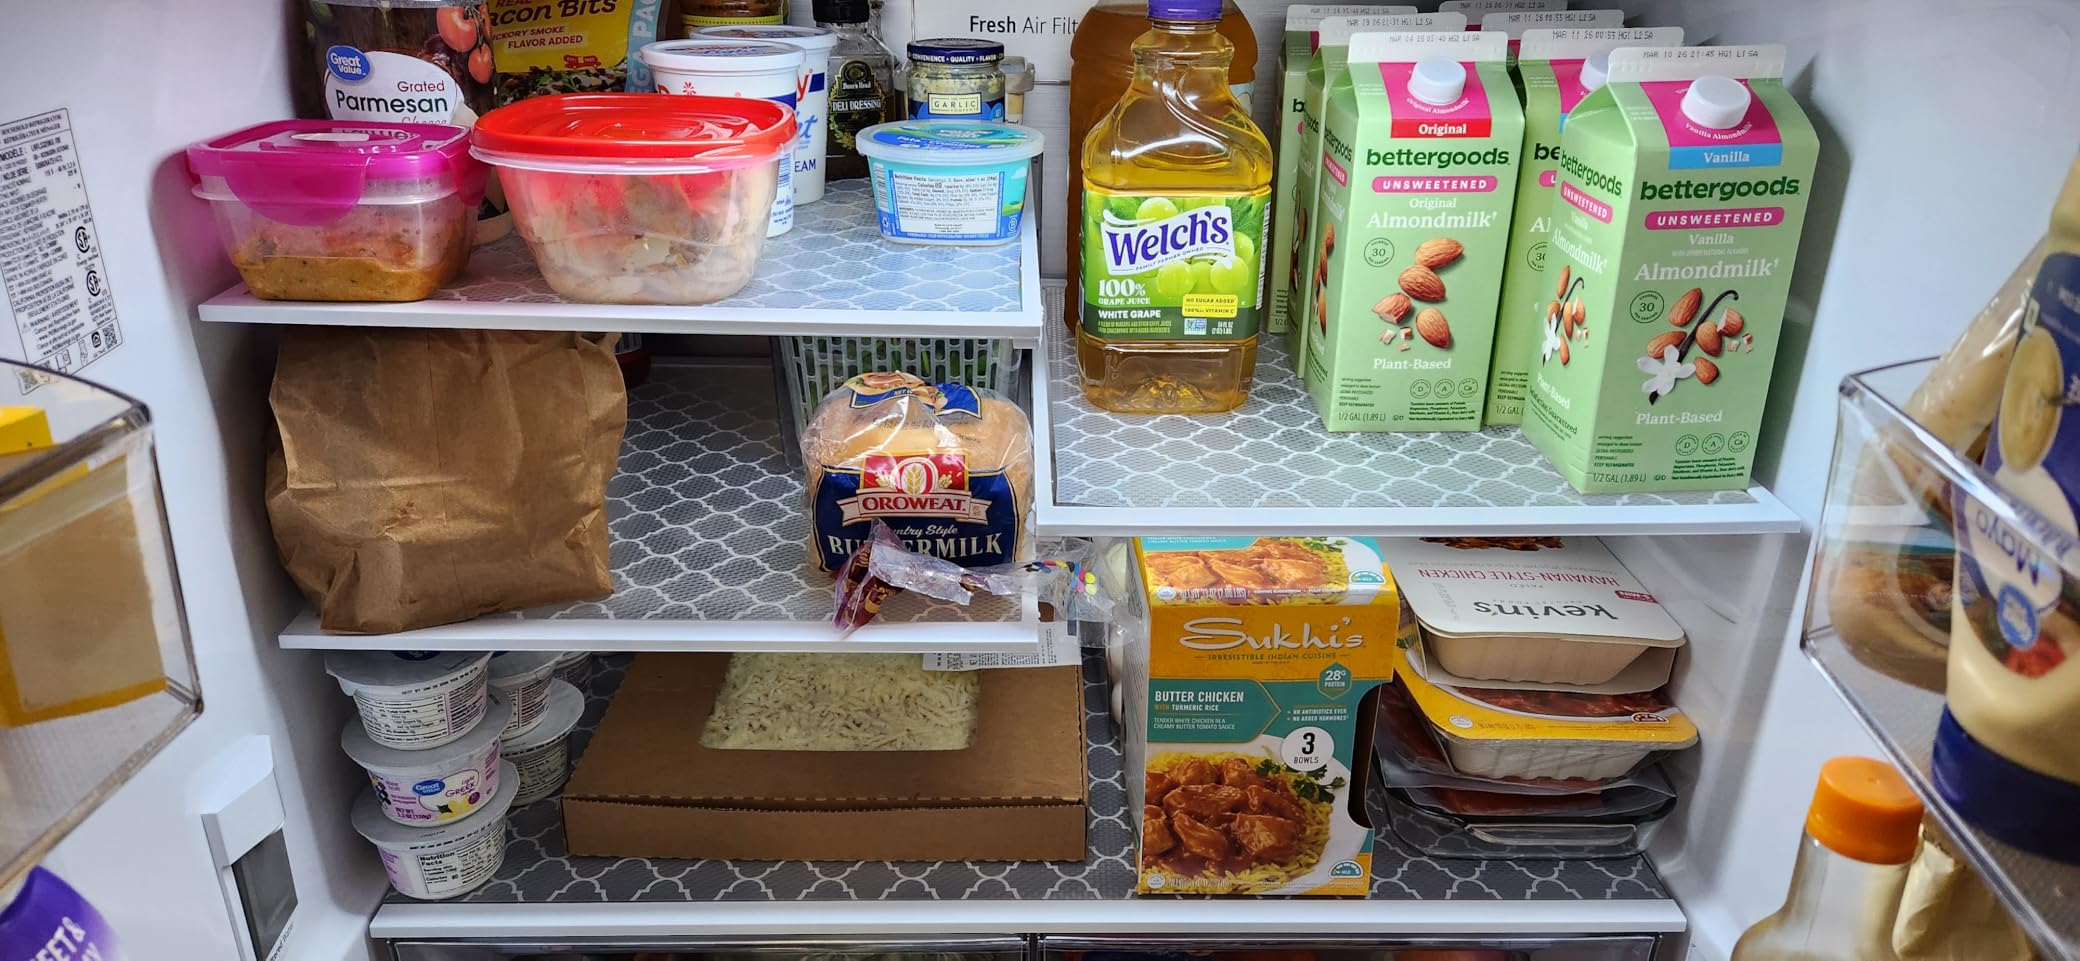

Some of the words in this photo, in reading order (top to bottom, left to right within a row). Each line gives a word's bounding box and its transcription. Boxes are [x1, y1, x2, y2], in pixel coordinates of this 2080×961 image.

[488, 4, 552, 27] acon
[1508, 13, 1520, 22] MAR
[1535, 13, 1544, 22] 26
[1588, 13, 1596, 22] SA
[969, 15, 1016, 33] Fresh
[1022, 16, 1046, 34] Air
[1052, 16, 1079, 34] Filt
[491, 29, 529, 41] ICKORY
[530, 26, 566, 36] SMOKE
[1552, 31, 1568, 40] MAR
[1571, 31, 1580, 40] 11
[1583, 31, 1594, 40] 26
[1618, 31, 1631, 40] HG1
[1643, 31, 1654, 40] SA
[508, 37, 547, 49] FLAVOR
[548, 34, 583, 46] ADDED
[330, 51, 362, 69] Great
[912, 52, 946, 63] CONVENIENCE
[950, 55, 975, 63] QUALITY
[979, 54, 997, 62] FLAVOR
[1643, 49, 1659, 58] MAR
[1663, 49, 1673, 58] 10
[1677, 49, 1688, 58] 26
[1718, 49, 1733, 58] HG1
[1747, 49, 1759, 58] SA
[337, 63, 363, 75] Value
[397, 80, 445, 93] Grated
[335, 90, 448, 113] Parmesan
[832, 101, 849, 112] DELI
[849, 98, 886, 110] DRESSING
[934, 100, 976, 108] GARLIC
[1406, 98, 1432, 113] Original
[1431, 98, 1470, 114] Almondmilk
[1418, 123, 1467, 137] Original
[1685, 122, 1712, 138] Vanilla
[1712, 121, 1753, 140] Almondmilk
[1365, 147, 1509, 169] bettergoods
[1703, 150, 1750, 164] Vanilla
[794, 158, 817, 173] EAM
[1561, 150, 1623, 197] bettergoods
[1382, 179, 1488, 190] UNSWEETENED
[1640, 176, 1800, 202] bettergoods
[1409, 197, 1457, 210] Original
[1563, 186, 1608, 219] UNSWEETENED
[1657, 211, 1773, 227] UNSWEETENED
[1105, 210, 1230, 267] Welch's
[1688, 233, 1735, 246] Vanilla
[1135, 261, 1157, 271] FAMILY
[1157, 252, 1181, 264] FARMER
[1182, 246, 1204, 256] OWNED
[1372, 248, 1386, 257] 30
[1098, 278, 1146, 298] 100%
[1098, 297, 1126, 305] GRAPE
[1126, 296, 1151, 305] JUICE
[1639, 302, 1655, 312] 30
[1098, 309, 1129, 319] WHITE
[1129, 309, 1162, 318] GRAPE
[1373, 358, 1453, 370] Plant-Based
[1537, 372, 1571, 409] Plant-Based
[1338, 412, 1349, 421] 1/2
[1349, 412, 1361, 421] GAL
[1362, 412, 1379, 422] (1.89
[1507, 405, 1520, 415] GAL
[1548, 406, 1578, 436] Guaranteed
[1635, 410, 1723, 425] Plant-Based
[1683, 441, 1691, 449] D
[1734, 438, 1743, 446] Ca
[1593, 473, 1605, 482] 1/2
[1605, 473, 1619, 483] GAL
[1620, 472, 1639, 483] (1.89
[862, 495, 964, 512] OROWEAT
[895, 527, 924, 539] untry
[925, 524, 959, 538] Style
[827, 532, 1003, 559] BUERMILK
[1419, 569, 1486, 580] CHICKEN
[1491, 570, 1620, 586] HAWAIIAN-STYLE
[1473, 600, 1619, 621] kevin's
[1179, 615, 1364, 651] Sukhi's
[1208, 653, 1265, 661] IRRESISTIBLE
[1267, 653, 1299, 661] INDIAN
[1302, 652, 1337, 660] CUISINE
[1155, 691, 1195, 702] BUTTER
[1198, 691, 1244, 703] CHICKEN
[1301, 731, 1316, 755] 3
[1293, 756, 1319, 765] BOWLS
[415, 782, 440, 792] Great
[461, 775, 475, 786] Light
[420, 851, 455, 861] Nutrition
